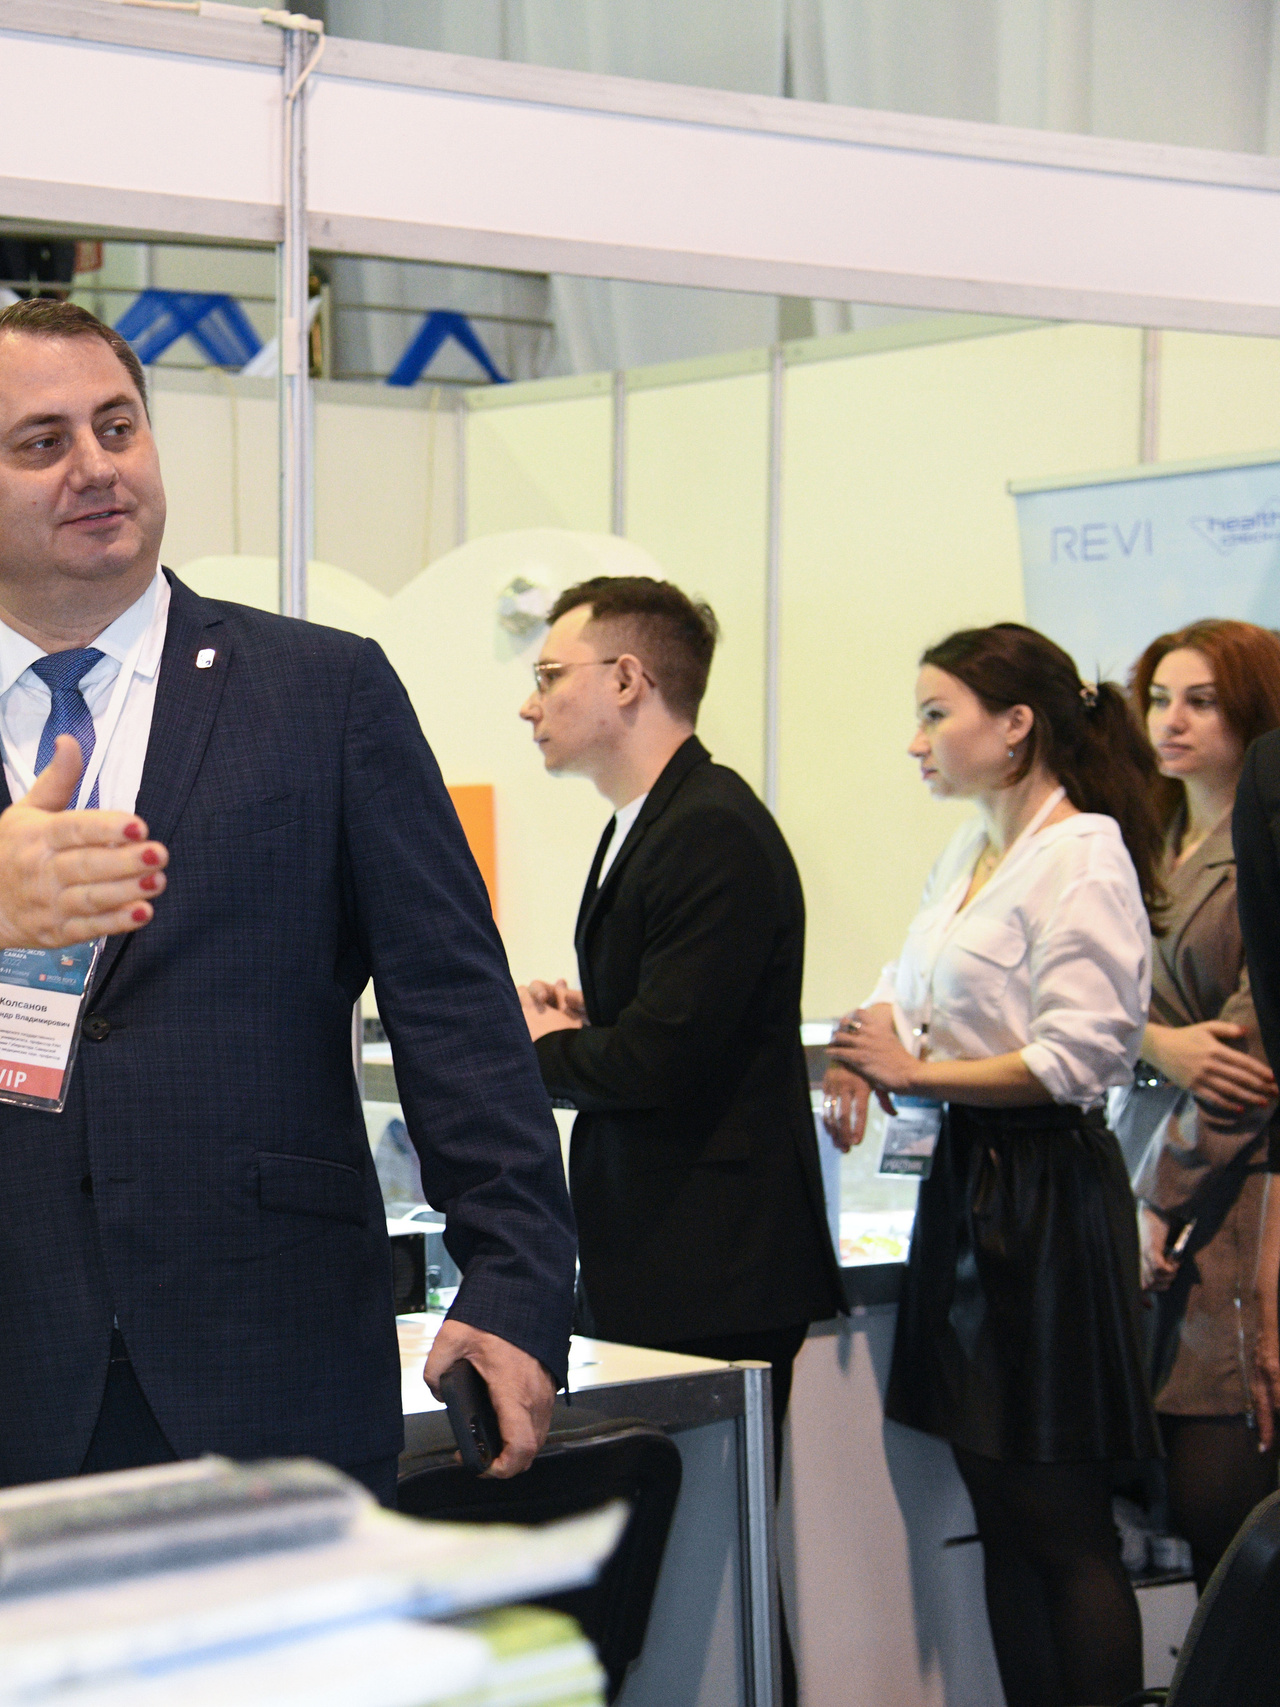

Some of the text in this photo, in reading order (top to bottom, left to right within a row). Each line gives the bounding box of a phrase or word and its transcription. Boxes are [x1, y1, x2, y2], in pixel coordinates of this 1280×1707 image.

[1050, 518, 1154, 563] REVI
[0, 997, 47, 1012] Колсанов
[16, 1013, 70, 1028] Владимирович
